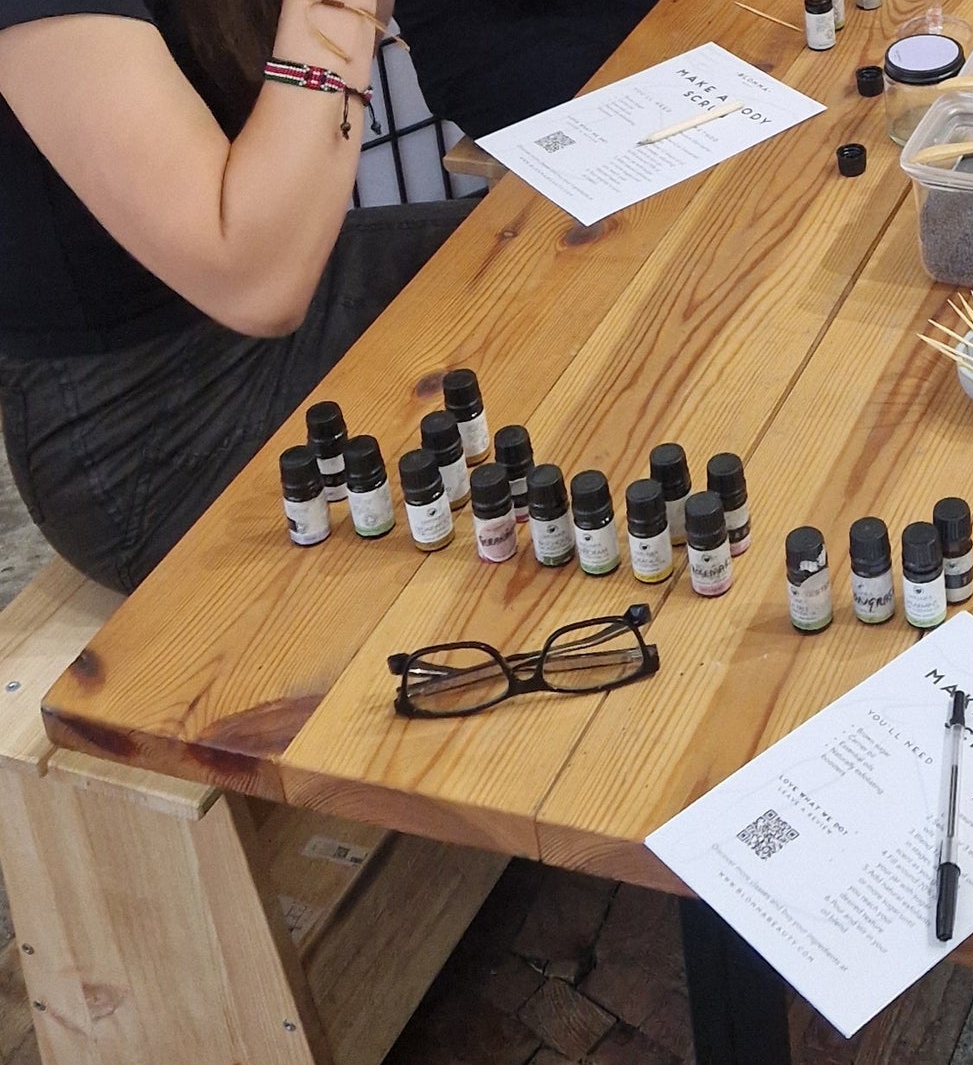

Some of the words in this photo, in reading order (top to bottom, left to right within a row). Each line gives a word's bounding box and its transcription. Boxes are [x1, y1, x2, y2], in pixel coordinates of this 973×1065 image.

[676, 69, 717, 93] MAKE
[741, 107, 772, 125] ODY
[838, 740, 865, 763] Essential
[904, 740, 933, 765] NEED
[830, 747, 855, 771] Naturally
[854, 768, 884, 795] exfoliating
[778, 774, 799, 792] LOVE
[799, 792, 821, 810] WHAT
[822, 811, 832, 822] WE
[833, 822, 848, 836] DO?
[867, 870, 884, 884] Add
